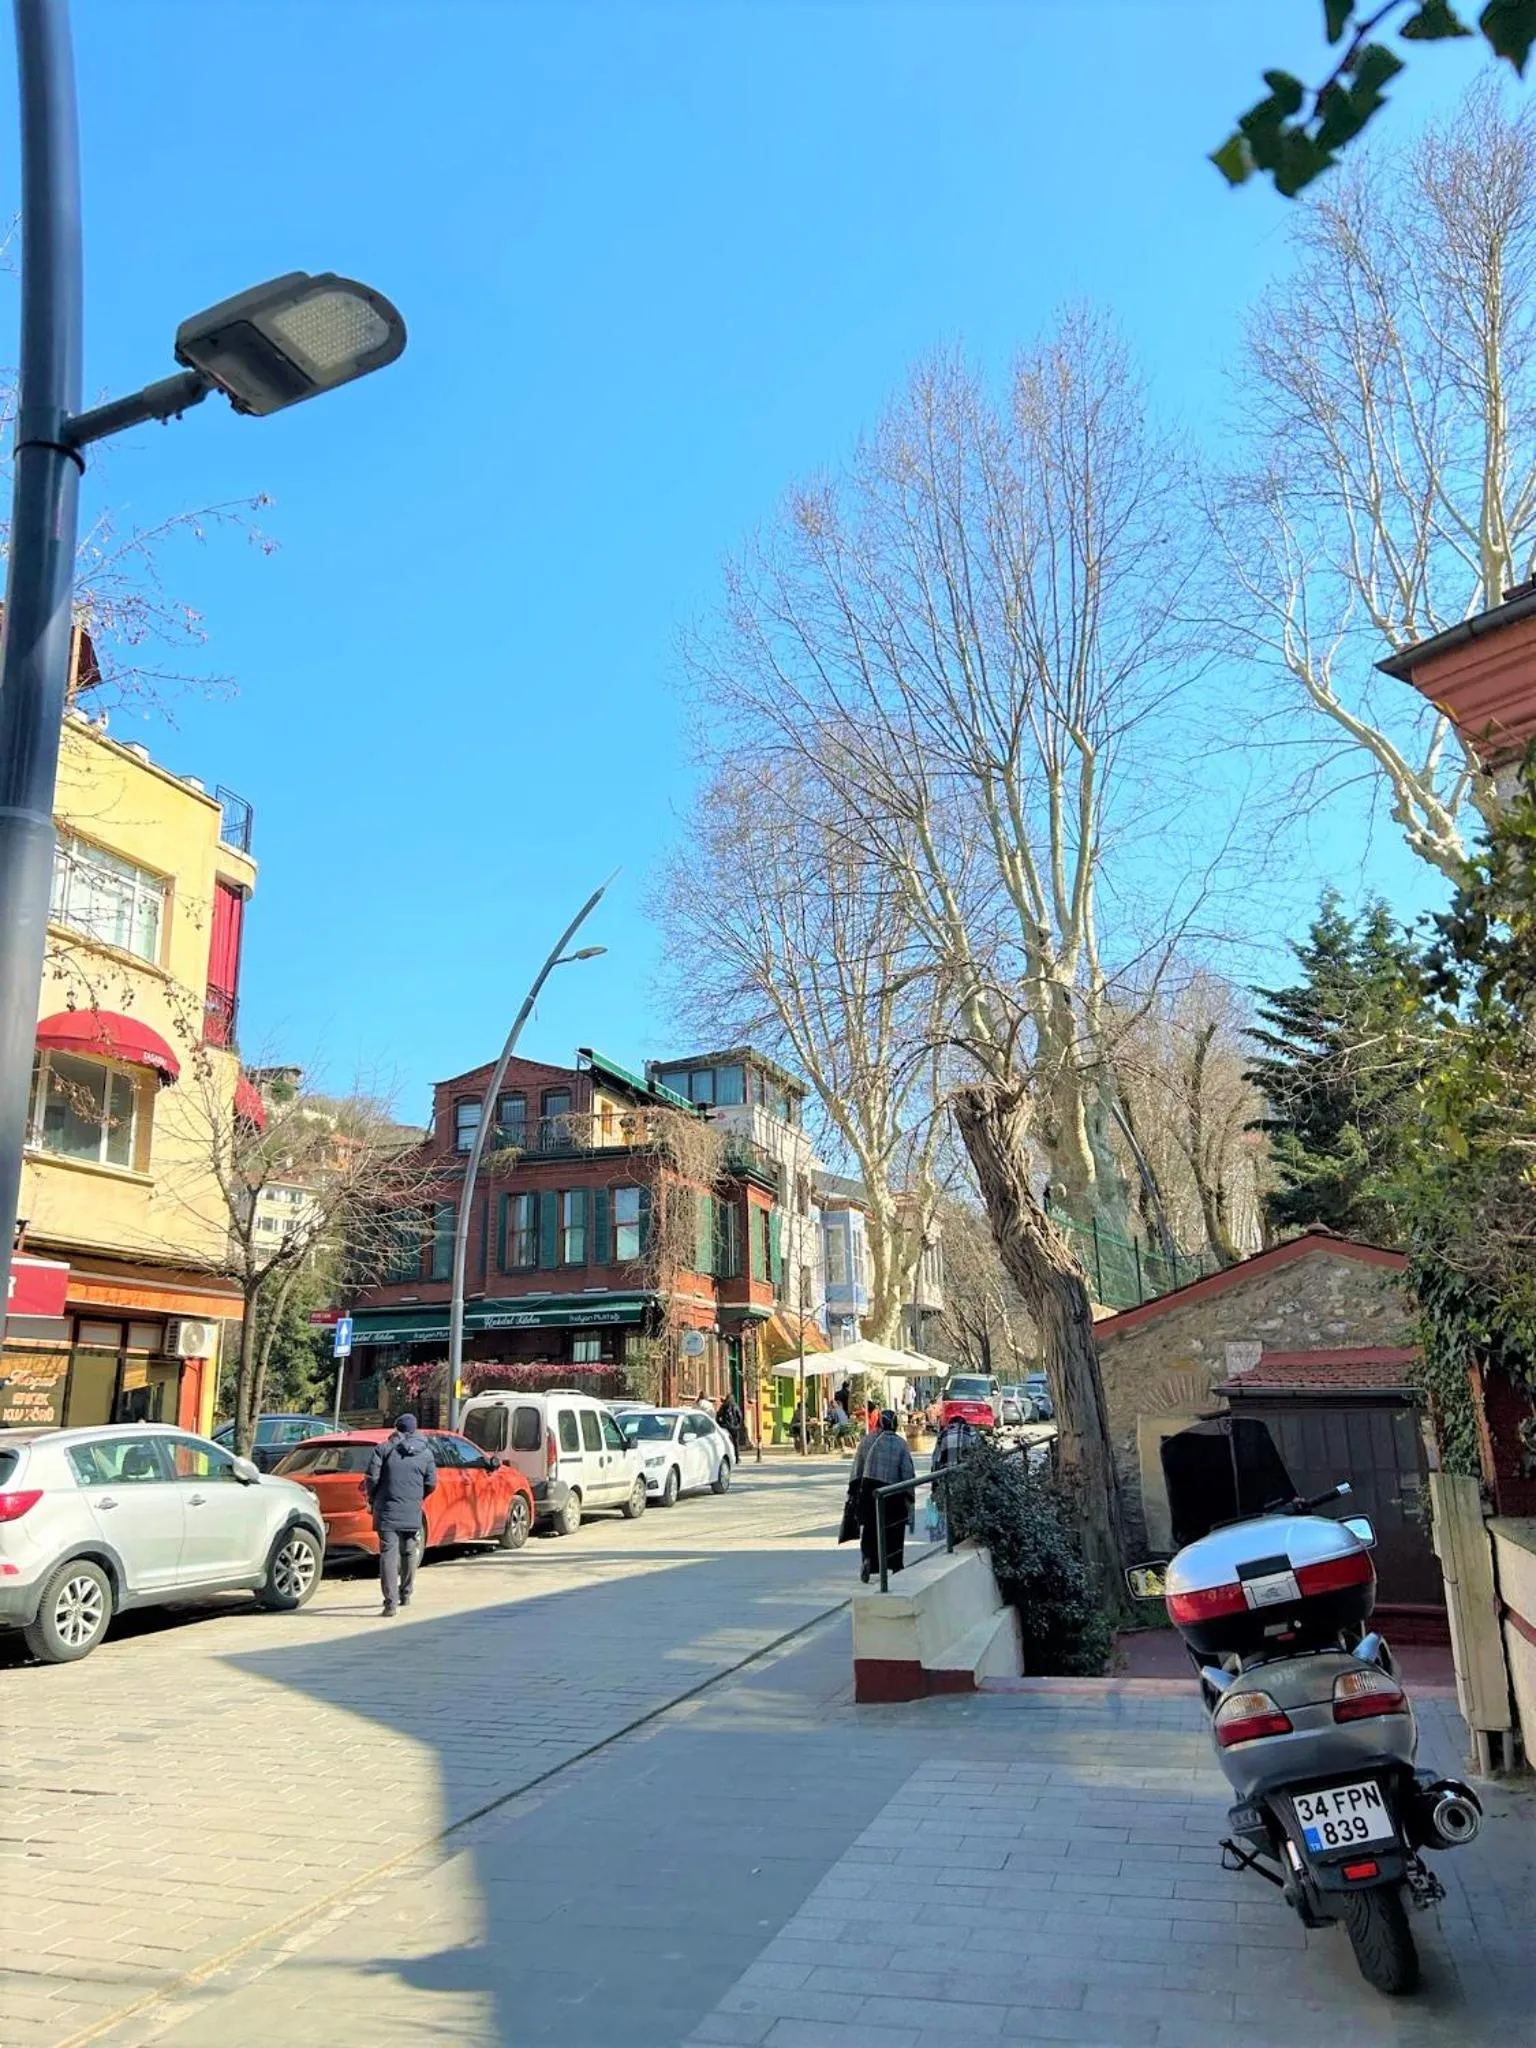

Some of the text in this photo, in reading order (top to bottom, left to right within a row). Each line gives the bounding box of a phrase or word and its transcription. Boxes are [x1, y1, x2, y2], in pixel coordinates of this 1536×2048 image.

[1298, 1785, 1381, 1821] 34 FPN
[1323, 1816, 1369, 1845] 839
